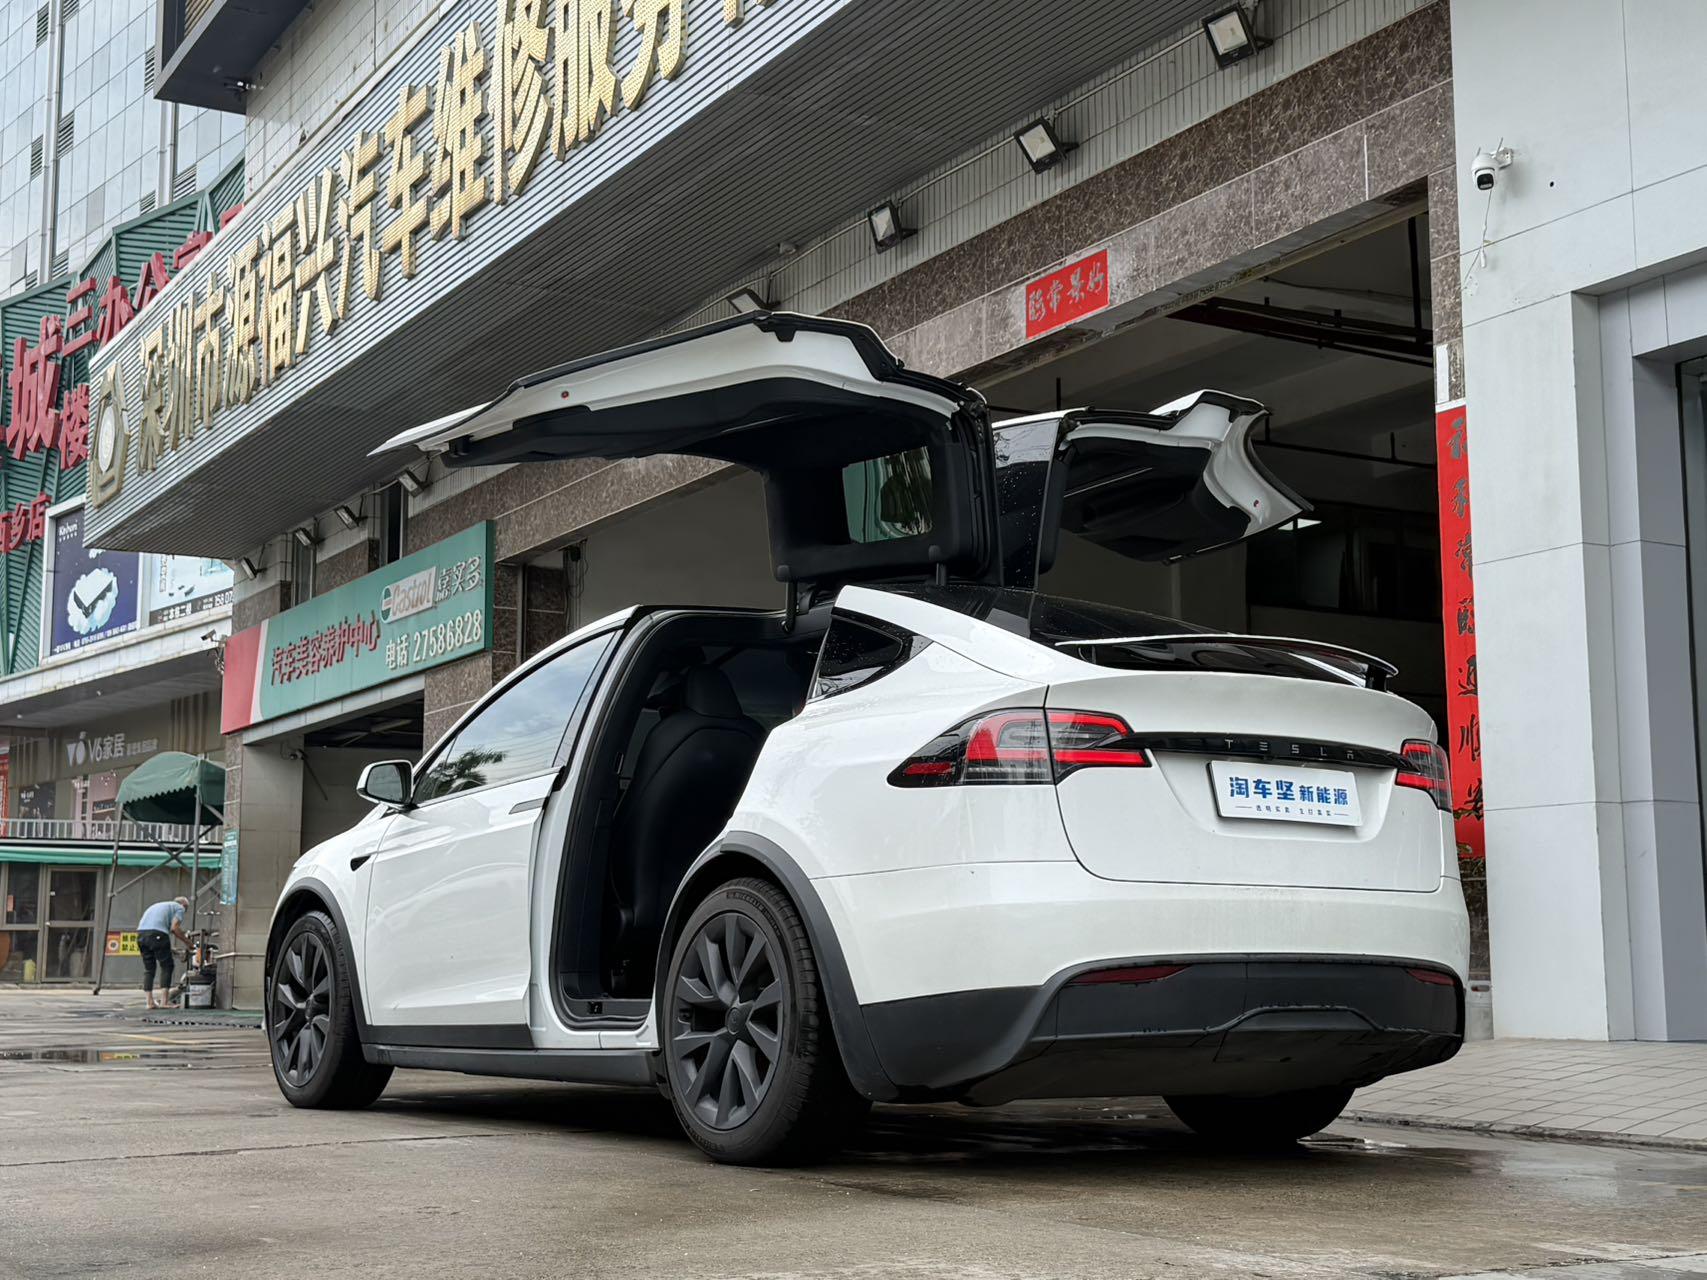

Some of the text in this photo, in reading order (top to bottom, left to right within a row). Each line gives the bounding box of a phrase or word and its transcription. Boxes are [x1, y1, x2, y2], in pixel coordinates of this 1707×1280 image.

[271, 609, 381, 687] 汽车美容养护中心
[385, 609, 482, 670] 电话 27586828
[1225, 739, 1355, 760] TESLA
